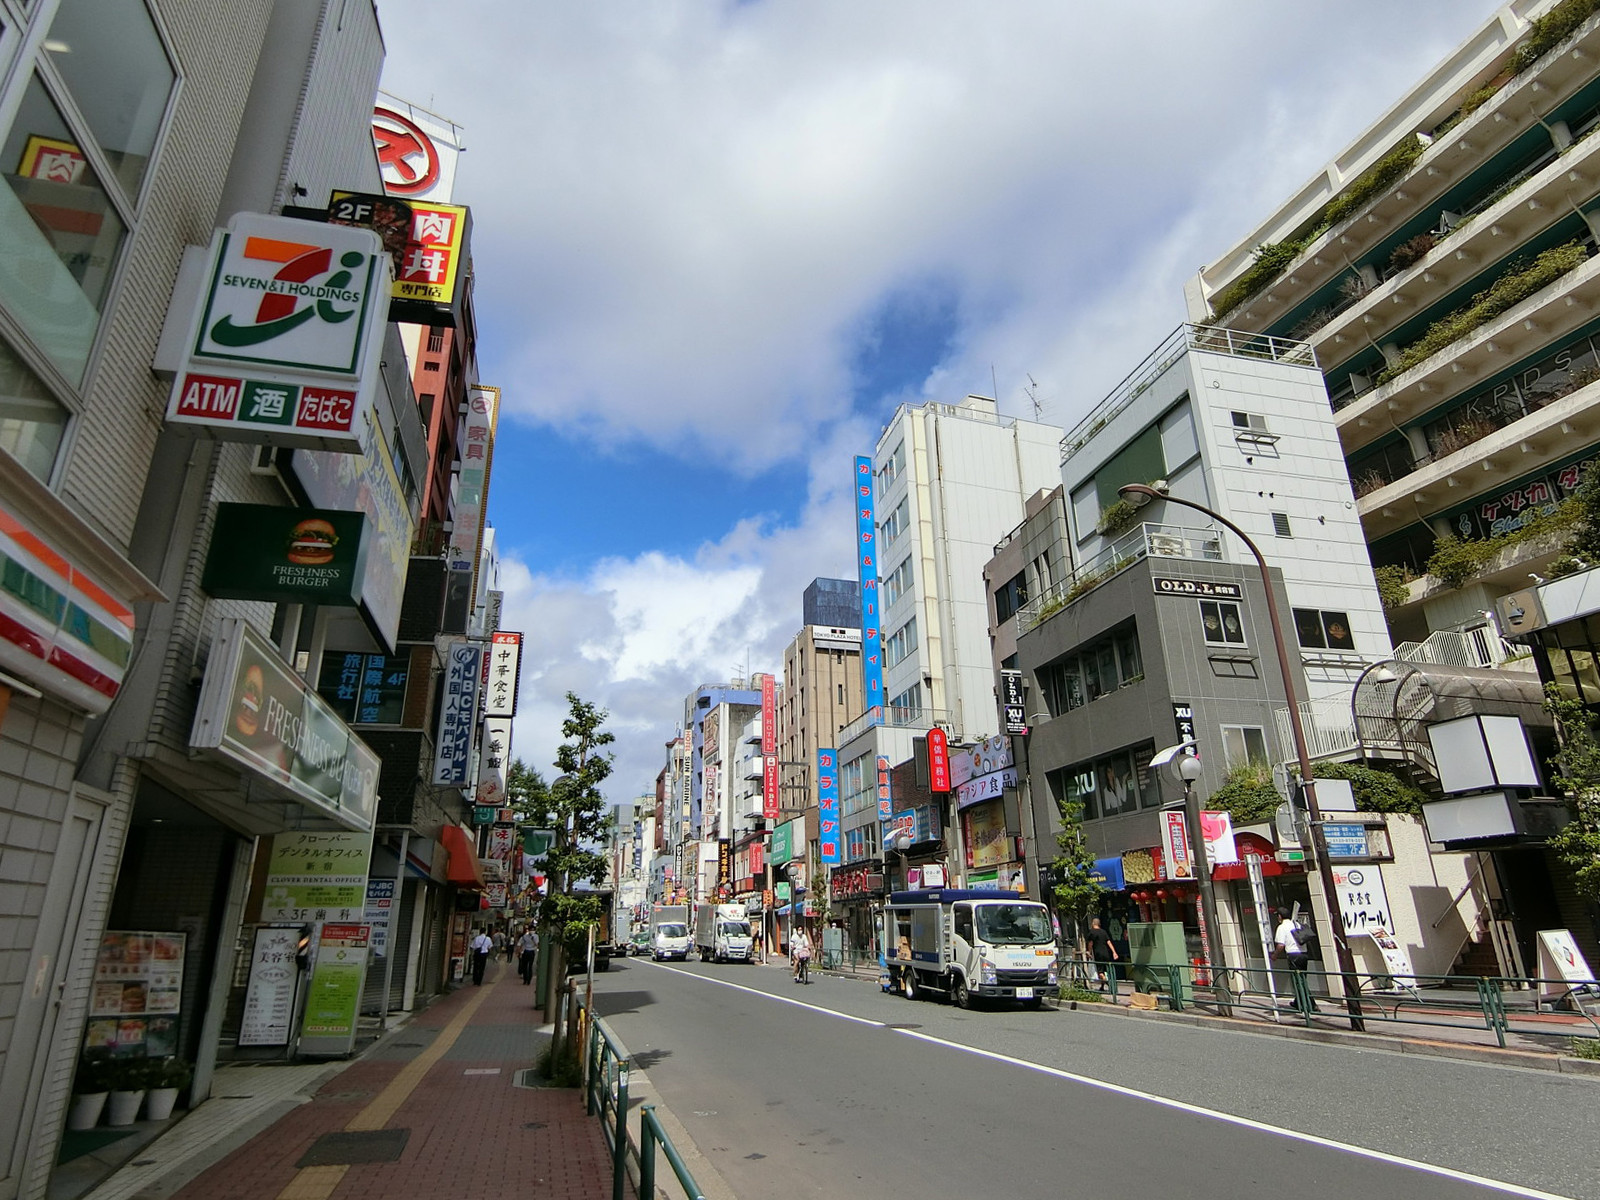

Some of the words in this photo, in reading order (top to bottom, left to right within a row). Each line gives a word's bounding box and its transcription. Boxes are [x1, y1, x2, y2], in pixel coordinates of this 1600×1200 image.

[337, 203, 372, 221] 2F
[404, 212, 452, 283] 肉丼
[288, 280, 361, 304] HOLDINGS
[400, 284, 443, 298] 専門店
[181, 381, 236, 414] ATM
[250, 386, 290, 420] 酒
[300, 394, 354, 426] たばこ
[466, 426, 487, 460] 家具
[273, 565, 340, 579] FRESHNESS
[278, 576, 330, 588] BURGER
[1161, 580, 1214, 595] OLD.L
[337, 654, 361, 700] 旅行社
[361, 655, 385, 723] 国際航空
[387, 673, 407, 686] 4F
[493, 650, 511, 709] 中華食堂
[440, 667, 462, 759] 外国人専門店
[453, 664, 476, 762] JBCモバイル
[1007, 709, 1022, 718] XU
[1175, 707, 1193, 718] XU
[264, 695, 332, 773] FRESHNESS
[487, 729, 506, 769] 一番館
[441, 768, 462, 781] 2F
[1074, 771, 1095, 796] XU
[820, 755, 837, 857] カラオケ館
[298, 834, 351, 845] クローバー
[279, 846, 363, 859] デンタルオフィス
[291, 909, 309, 921] 3F
[314, 908, 351, 921] 歯科
[1342, 910, 1387, 929] ルノアール
